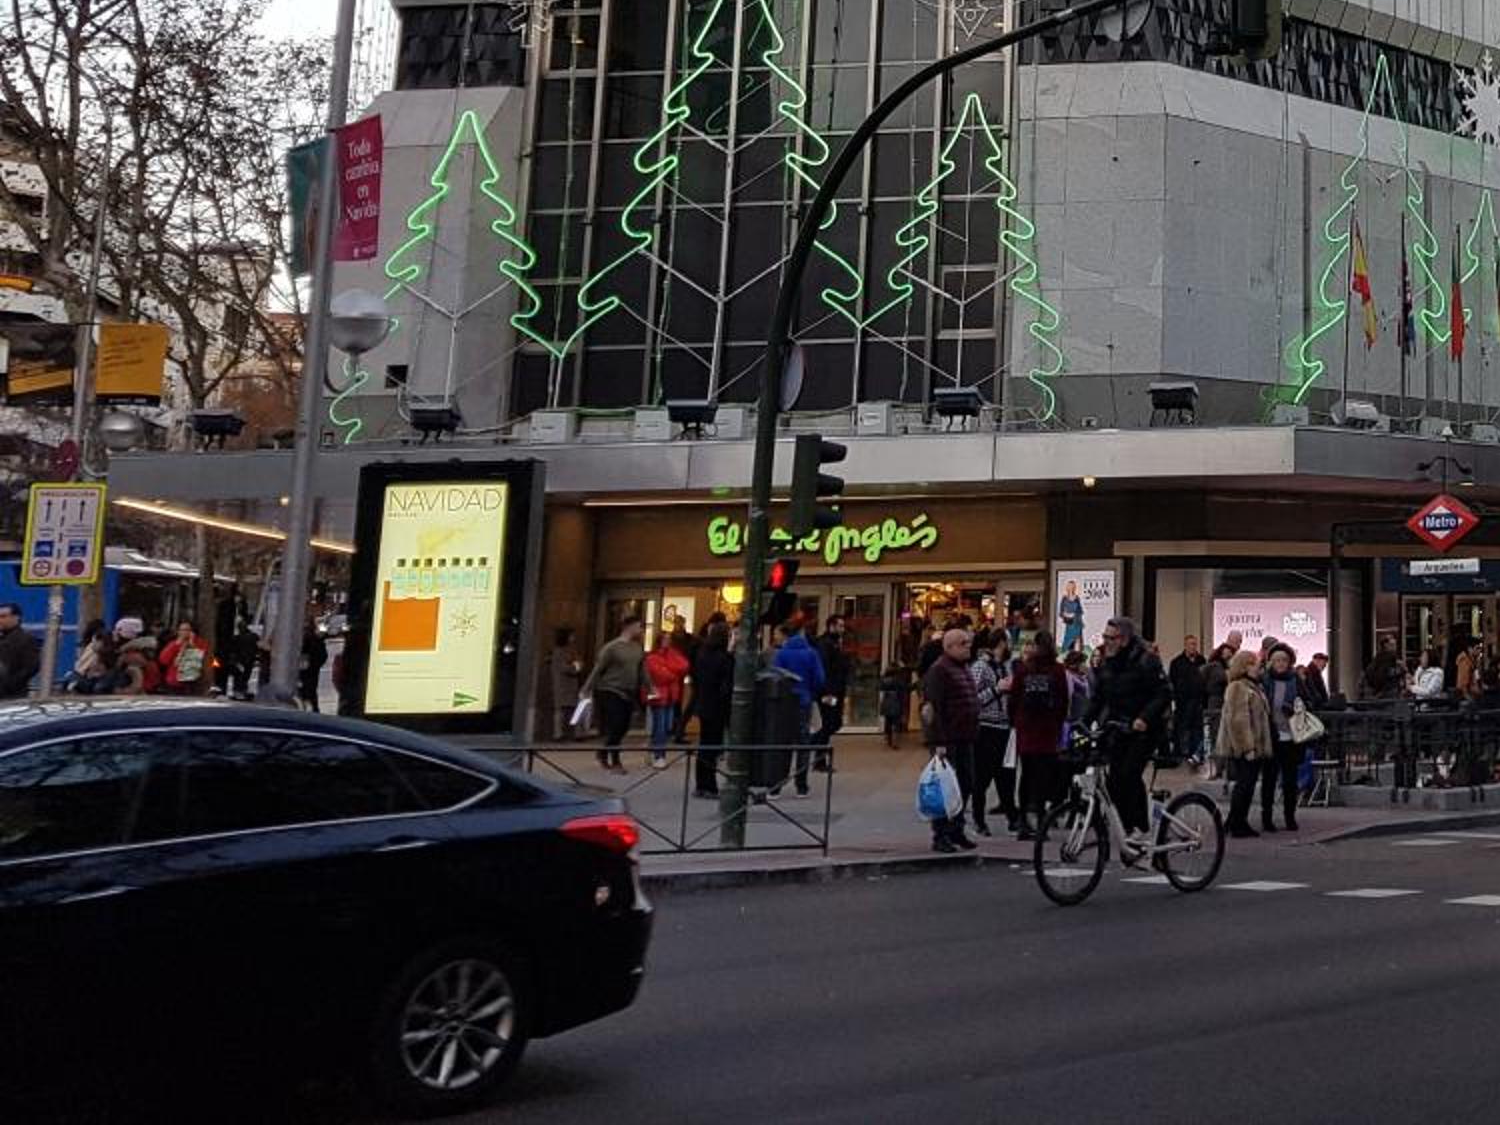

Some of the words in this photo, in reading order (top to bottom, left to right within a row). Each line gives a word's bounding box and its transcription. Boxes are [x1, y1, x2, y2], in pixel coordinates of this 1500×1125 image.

[388, 488, 503, 512] NAVIDAD
[1425, 516, 1457, 529] Metro
[707, 516, 743, 554] El
